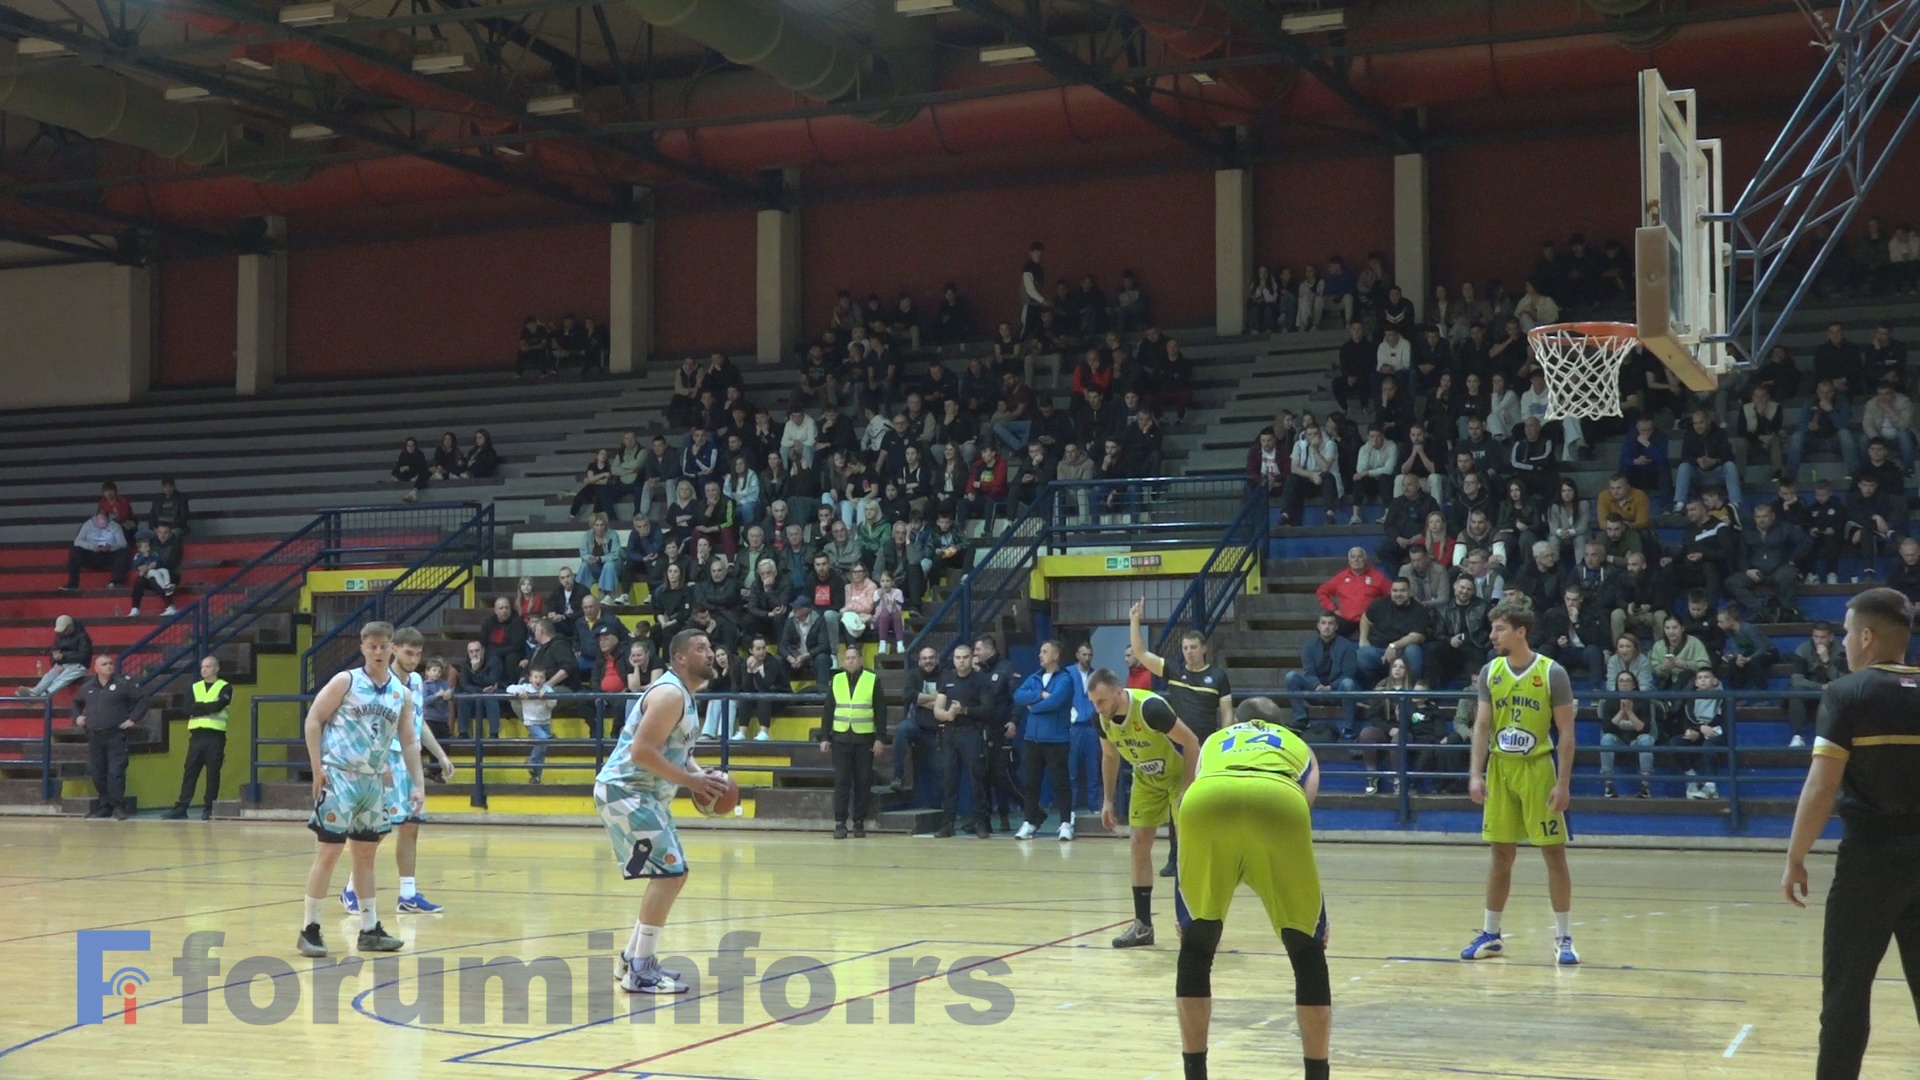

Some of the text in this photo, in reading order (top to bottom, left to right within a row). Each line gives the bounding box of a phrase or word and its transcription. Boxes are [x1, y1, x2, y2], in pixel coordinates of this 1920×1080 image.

[1495, 696, 1540, 711] KK MIKS
[1511, 708, 1522, 723] 12
[370, 723, 379, 740] 5
[1218, 733, 1285, 753] 14
[1540, 819, 1559, 837] 12
